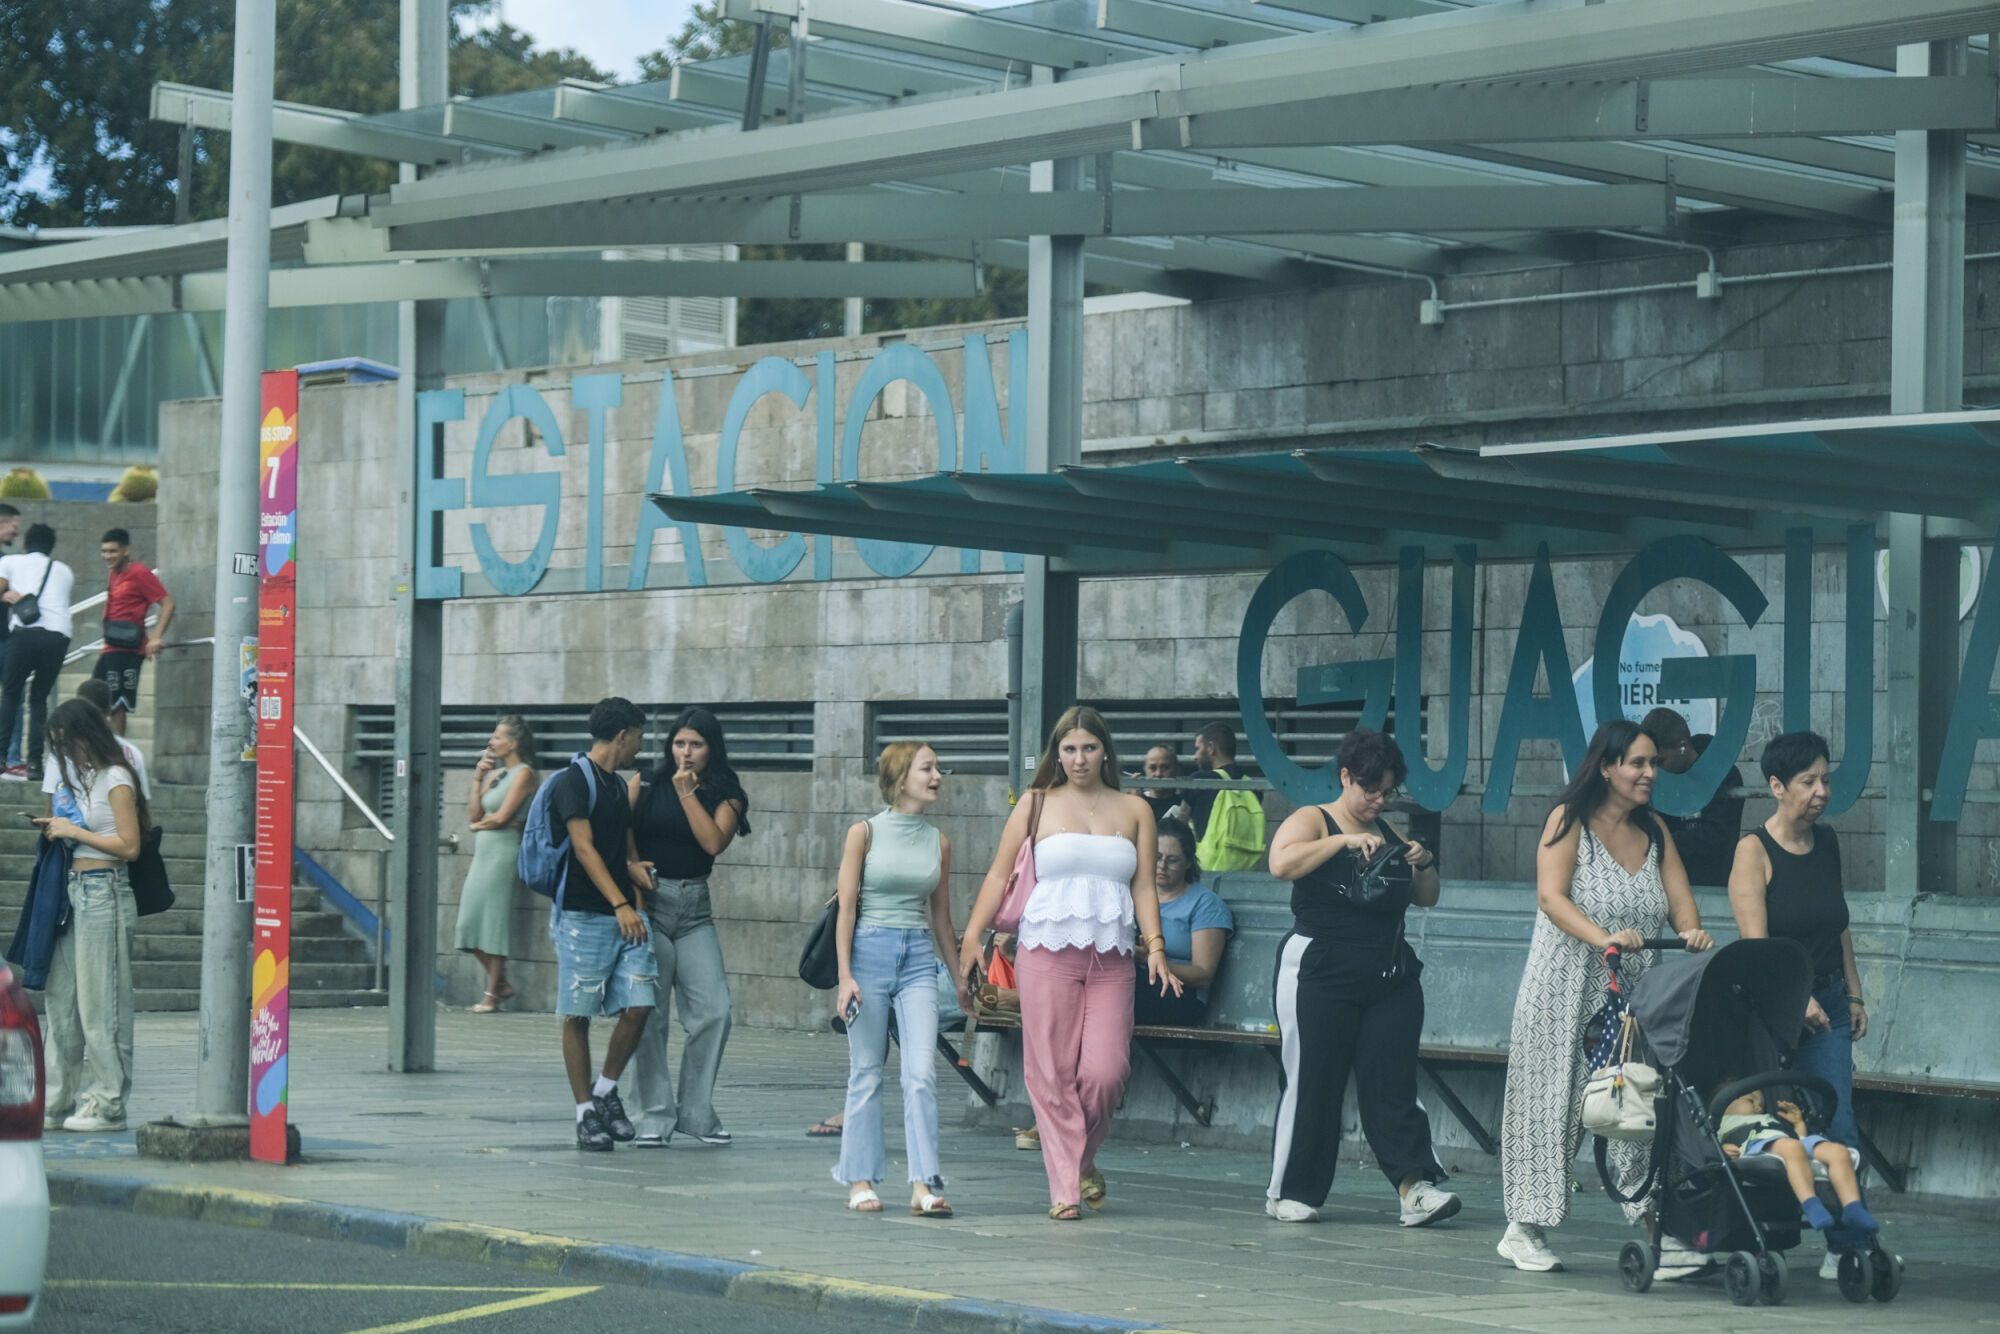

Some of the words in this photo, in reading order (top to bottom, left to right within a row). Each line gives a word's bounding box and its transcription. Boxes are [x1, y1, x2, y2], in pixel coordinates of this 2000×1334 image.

[266, 456, 280, 499] 7
[416, 328, 1027, 599] ESTACION
[1619, 662, 1632, 673] No
